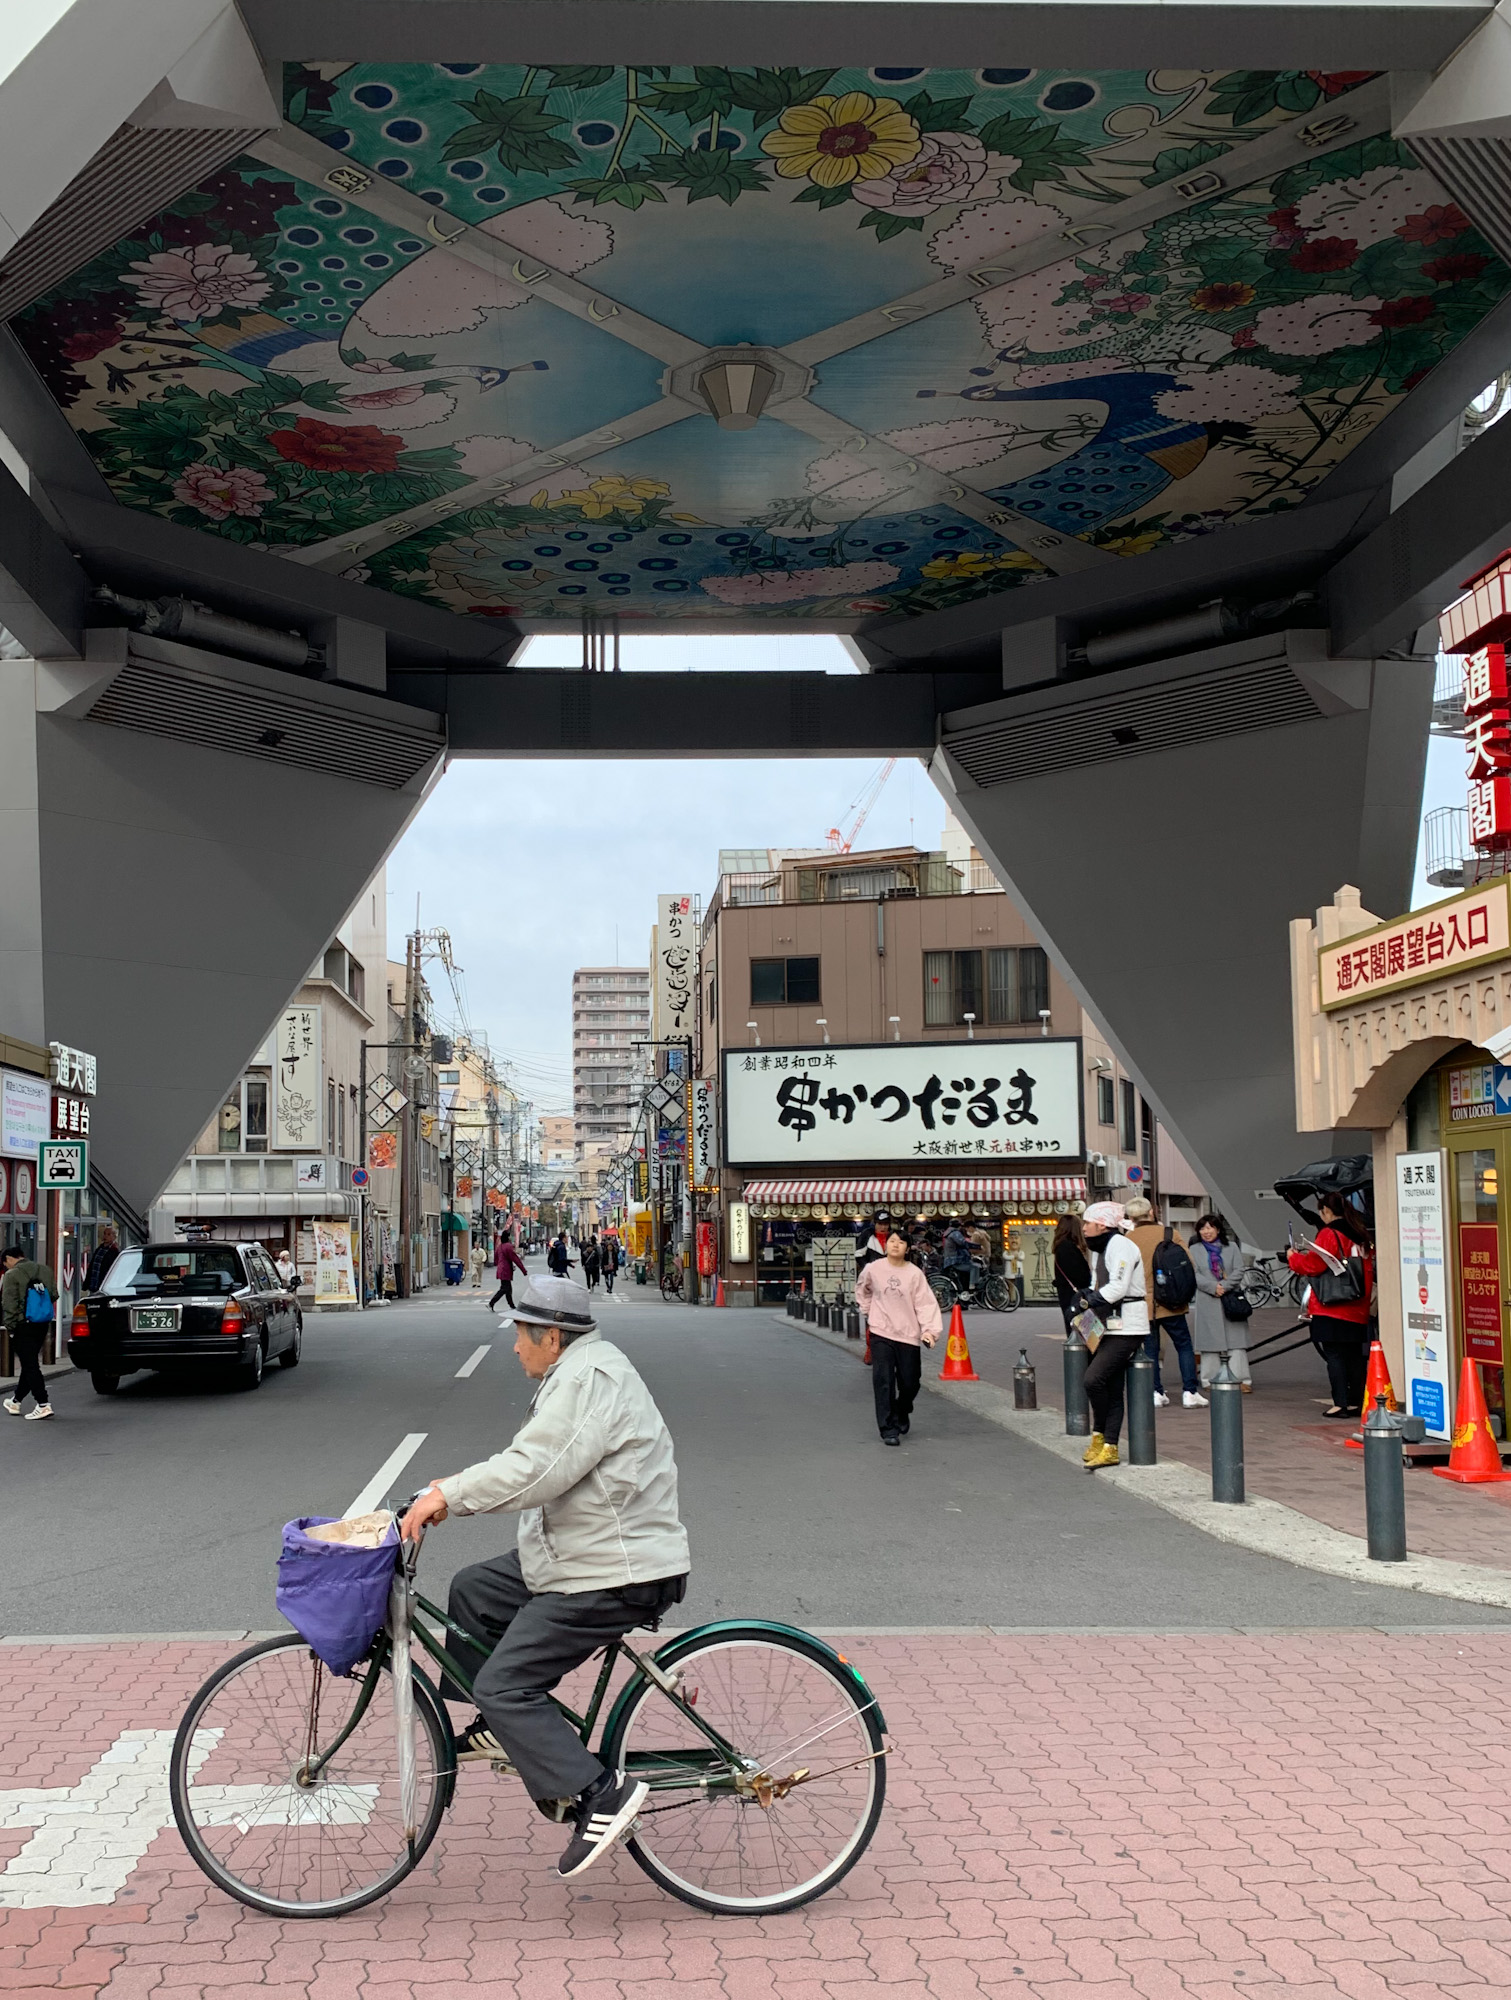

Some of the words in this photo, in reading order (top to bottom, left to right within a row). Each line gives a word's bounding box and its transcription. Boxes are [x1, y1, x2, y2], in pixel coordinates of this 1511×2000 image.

[1462, 646, 1496, 846] 通天閣
[669, 901, 682, 938] 串かつ
[1337, 905, 1489, 993] 通天閣展望台入口
[54, 1042, 97, 1096] 通天閣
[739, 1054, 838, 1072] 創業昭和四年
[649, 1093, 668, 1101] BABY
[776, 1068, 1039, 1142] 串かつだるま
[57, 1097, 90, 1134] 展望台
[1452, 1107, 1468, 1120] COIN
[1468, 1103, 1494, 1118] LOCKER
[696, 1086, 713, 1167] 串かつだるま
[46, 1148, 78, 1158] TAXI
[912, 1138, 1062, 1156] 大阪新世界元祖串かつ
[652, 1147, 660, 1182] BABY
[1403, 1165, 1435, 1185] 通天閣
[1404, 1188, 1436, 1197] TSUTENKAKU
[1470, 1251, 1490, 1264] 通天閣
[1467, 1283, 1496, 1296] うしろです
